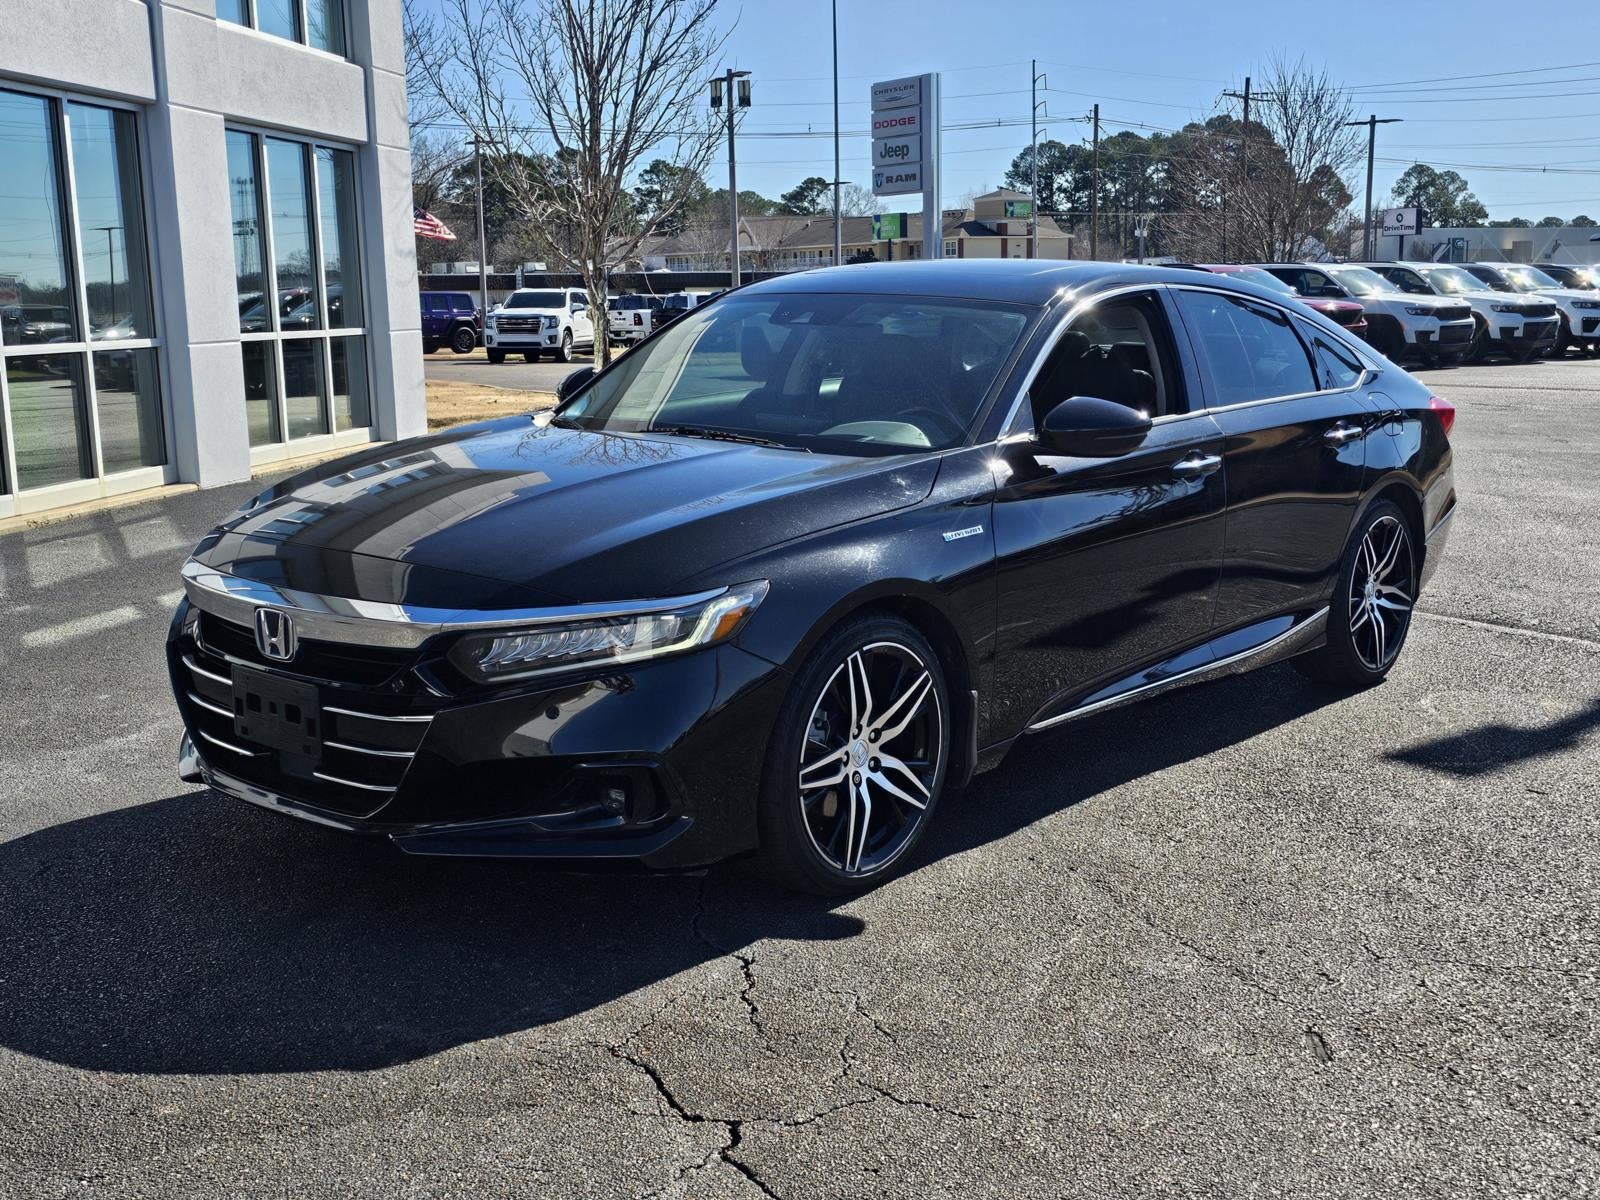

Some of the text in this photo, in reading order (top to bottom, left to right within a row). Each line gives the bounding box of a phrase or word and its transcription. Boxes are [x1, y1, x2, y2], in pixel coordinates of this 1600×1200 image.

[874, 84, 914, 96] CHRYSLER
[873, 116, 916, 129] DODGE
[880, 143, 910, 160] Jeep
[885, 173, 917, 184] RAM
[1384, 224, 1415, 232] DriveTime
